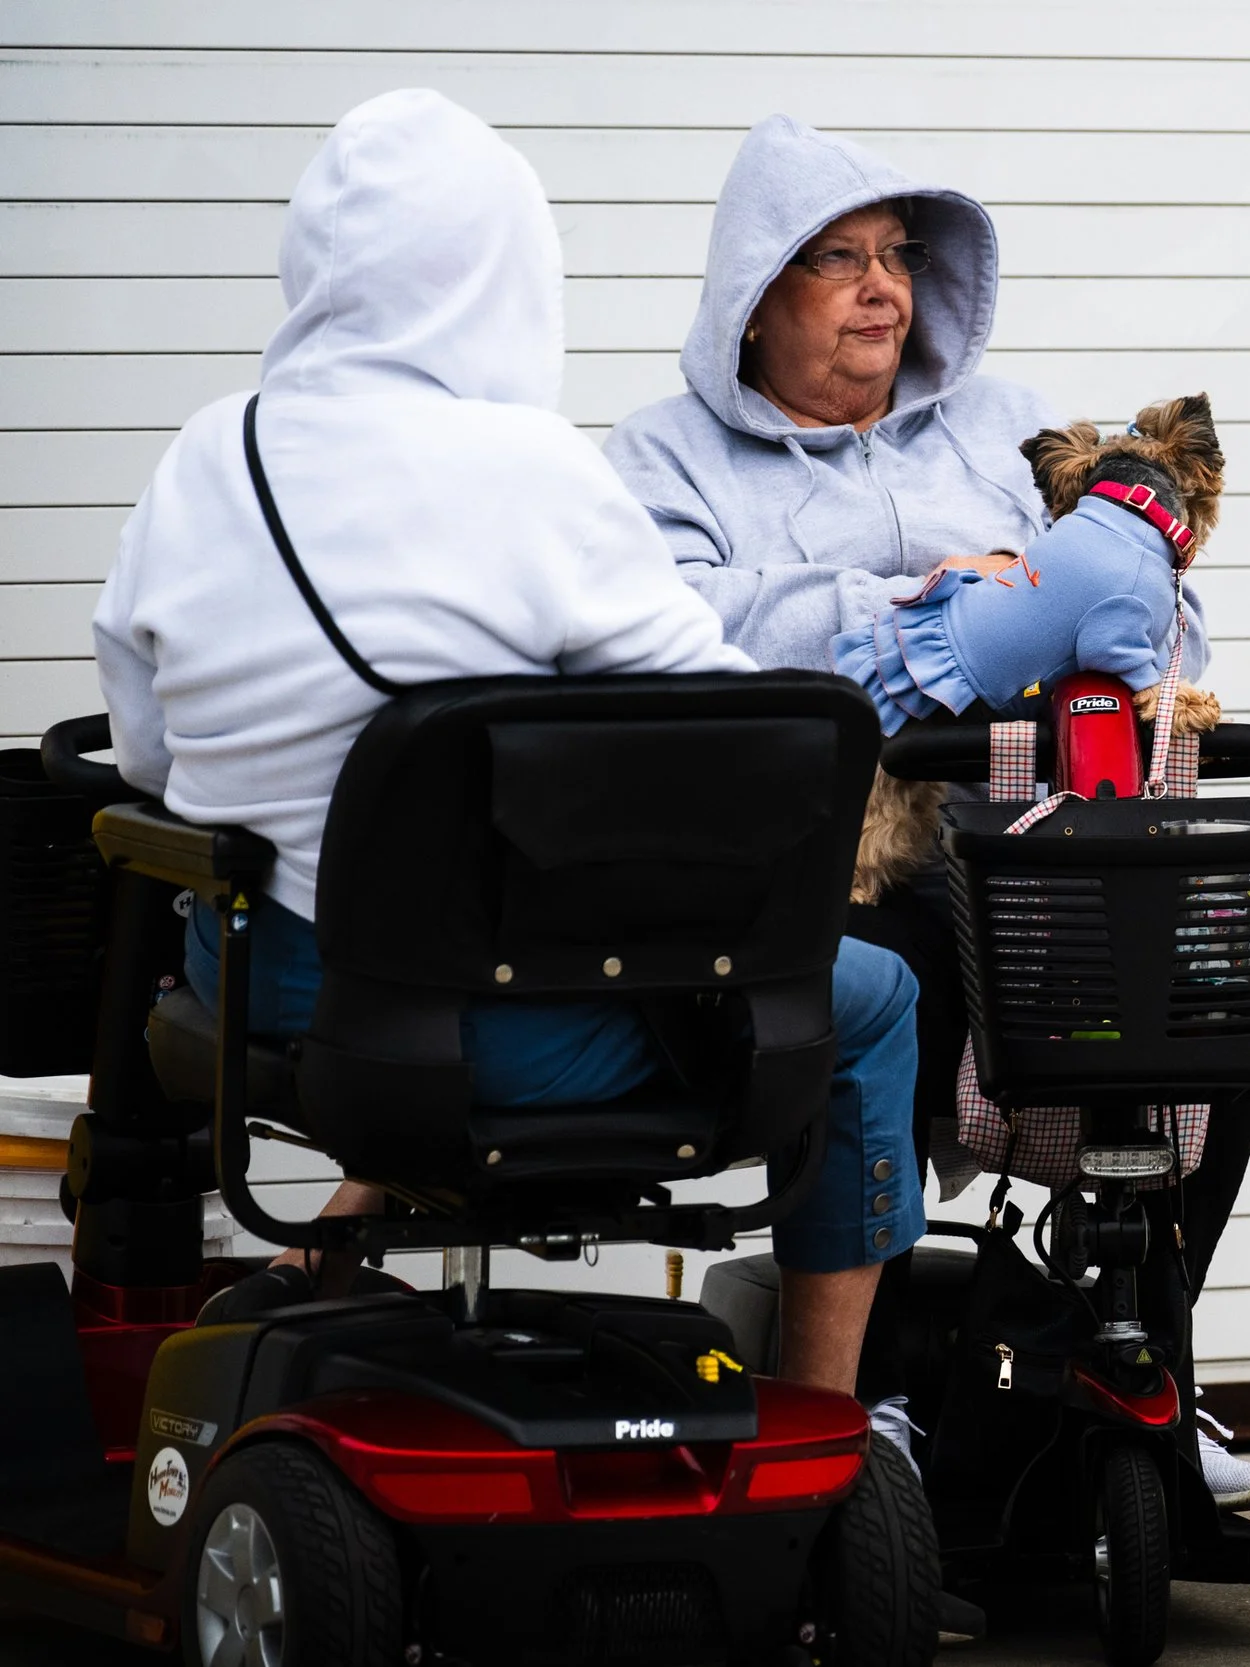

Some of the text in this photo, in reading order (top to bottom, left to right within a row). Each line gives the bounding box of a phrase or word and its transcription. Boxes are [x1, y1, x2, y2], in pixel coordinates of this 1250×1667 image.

[1077, 698, 1113, 709] Pride
[153, 1414, 199, 1437] VICTORY
[615, 1418, 675, 1440] Pride
